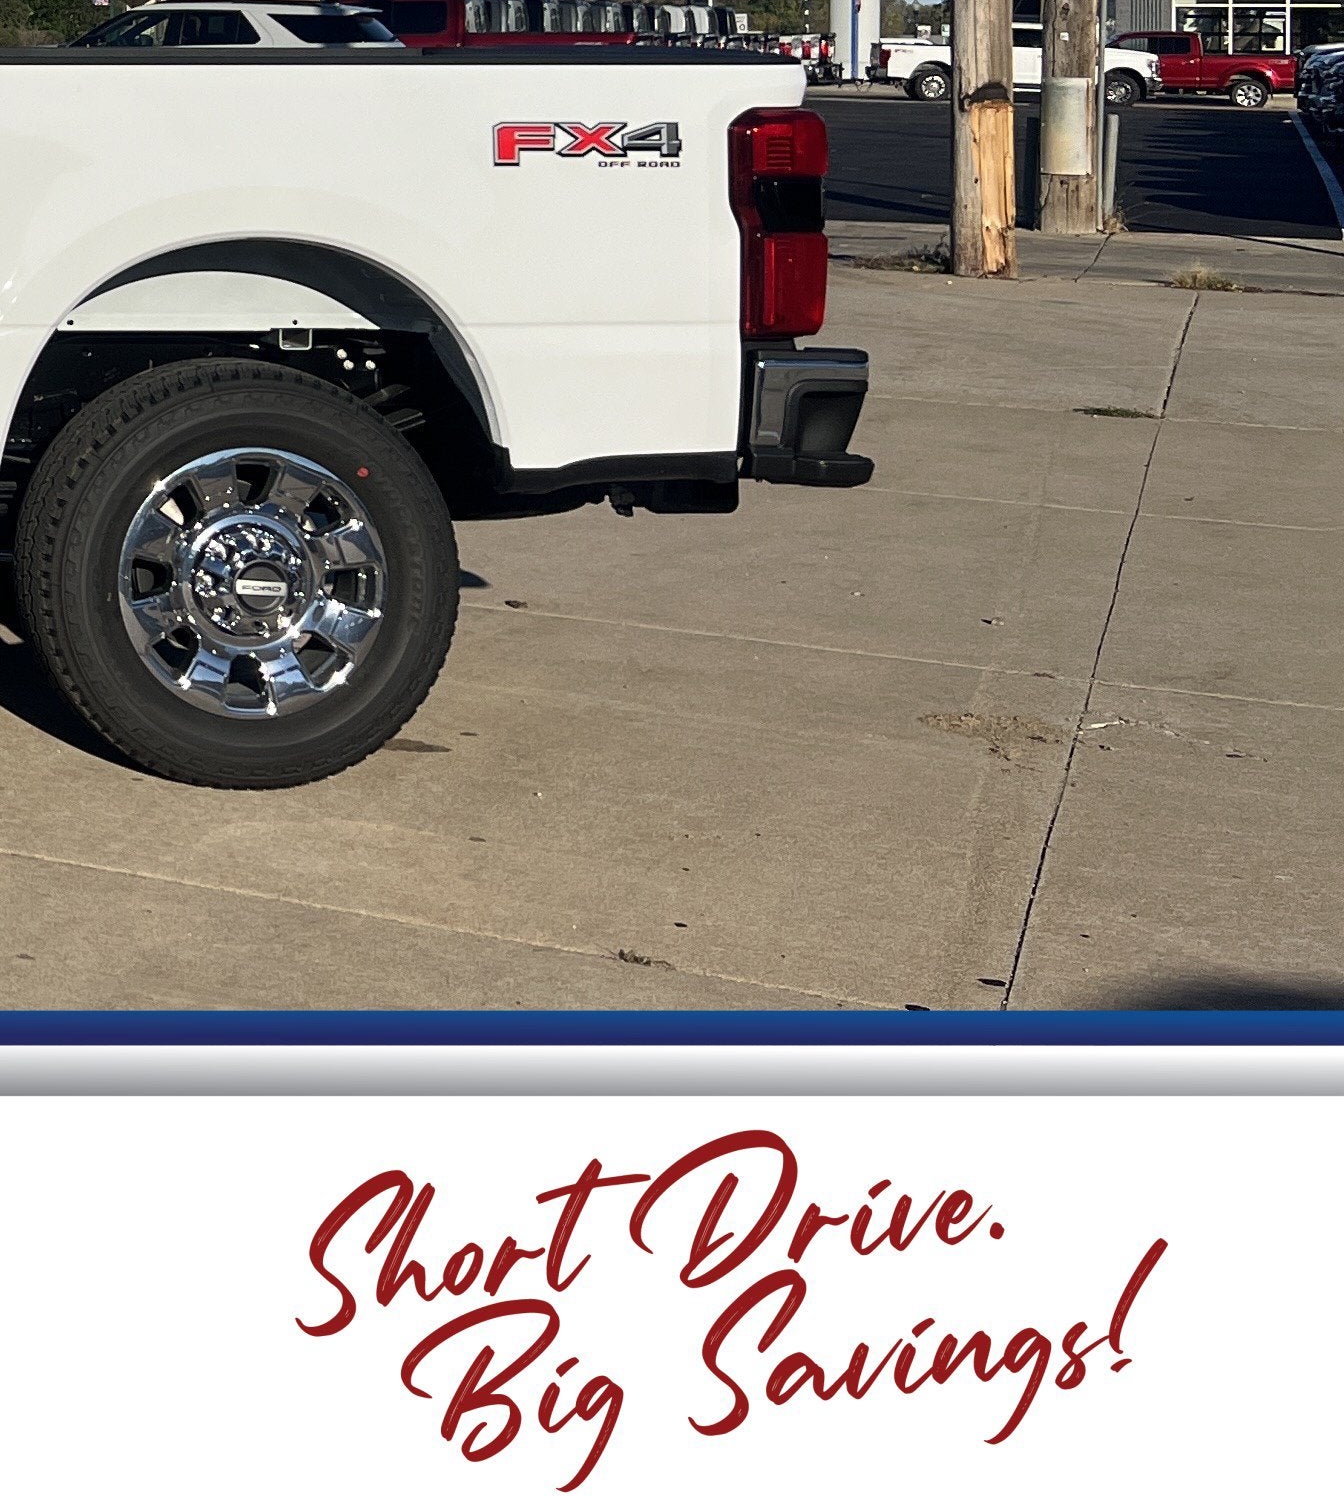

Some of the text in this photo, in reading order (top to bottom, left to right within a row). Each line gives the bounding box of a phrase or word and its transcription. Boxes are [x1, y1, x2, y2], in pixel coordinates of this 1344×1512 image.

[493, 122, 682, 167] FX4
[598, 160, 681, 168] OFF ROAD
